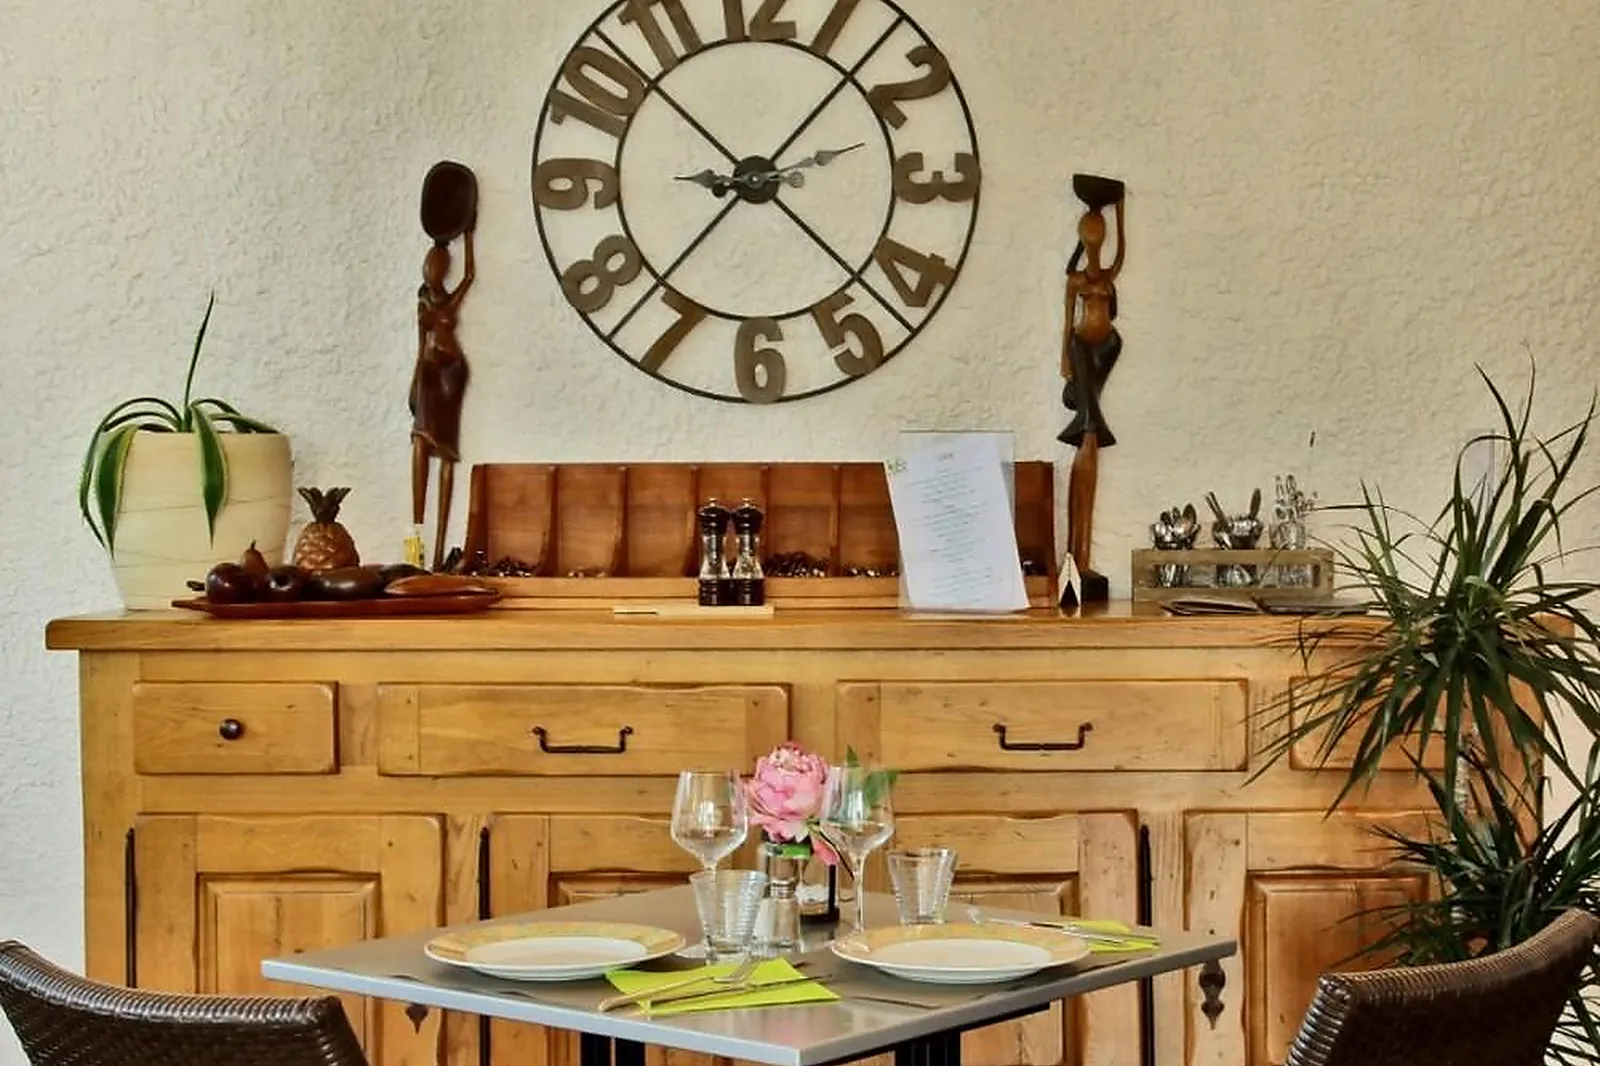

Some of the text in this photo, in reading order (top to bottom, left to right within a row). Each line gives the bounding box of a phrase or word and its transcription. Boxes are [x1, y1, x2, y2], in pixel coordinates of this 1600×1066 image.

[618, 0, 704, 71] 11
[548, 45, 648, 139] 10
[866, 45, 951, 130] 2
[532, 157, 619, 211] 9
[894, 151, 980, 205] 3
[561, 234, 643, 314] 8
[873, 236, 957, 307] 4
[639, 289, 708, 372] 7
[734, 316, 787, 401] 6
[810, 293, 885, 376] 5
